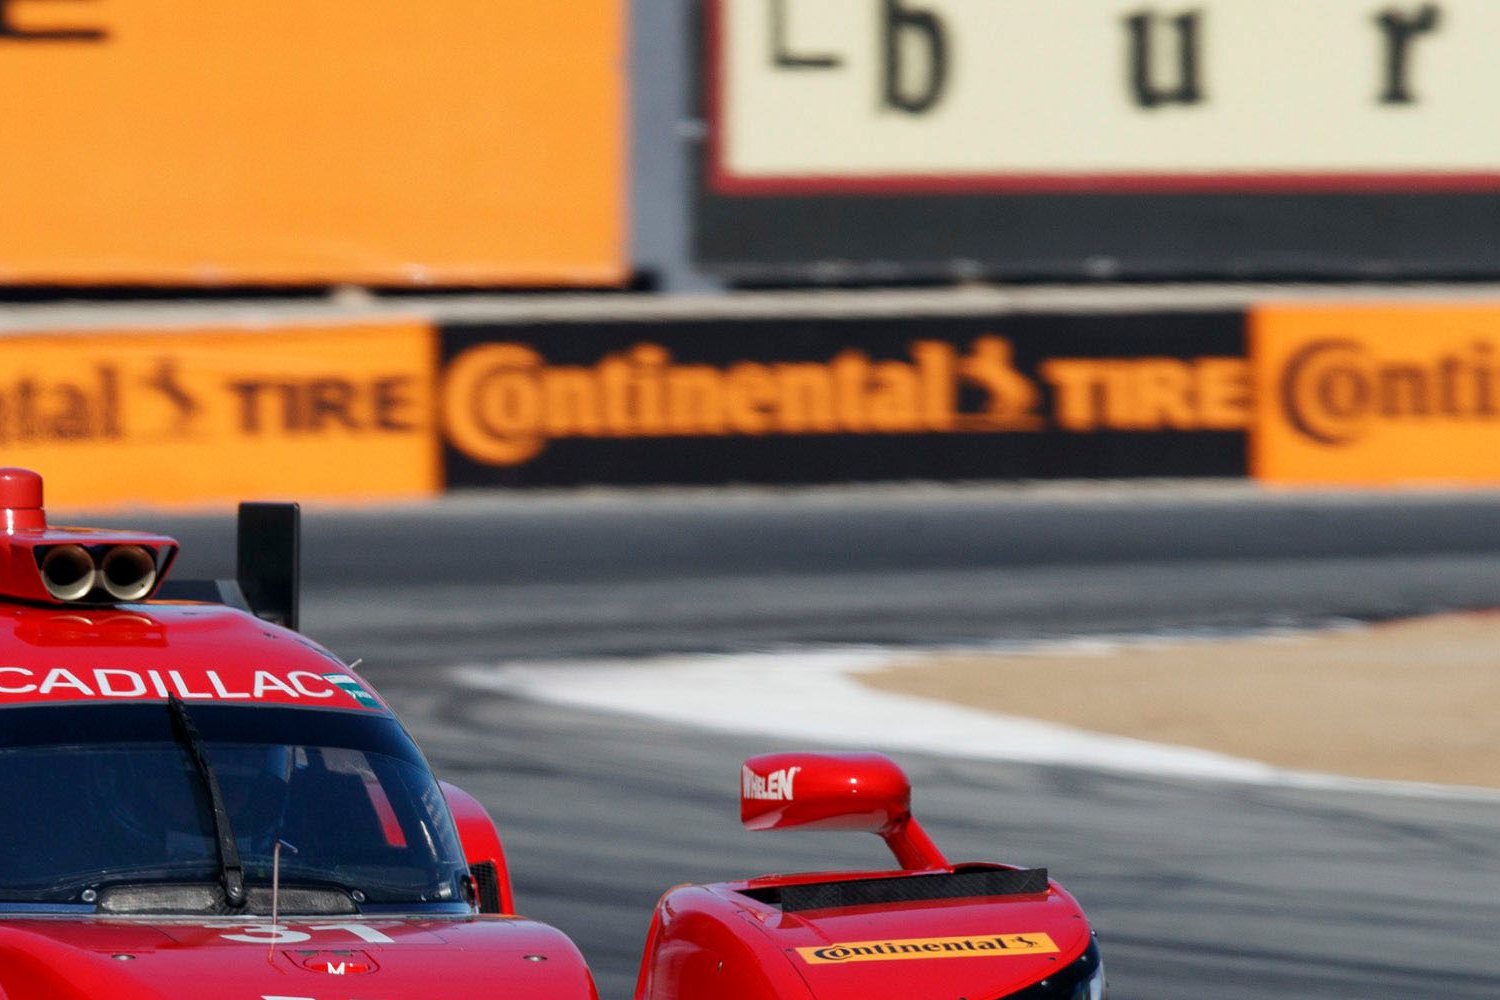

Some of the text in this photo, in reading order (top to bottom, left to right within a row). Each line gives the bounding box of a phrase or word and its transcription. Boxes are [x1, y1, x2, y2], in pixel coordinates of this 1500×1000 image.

[228, 376, 419, 436] TIRE
[444, 338, 1250, 466] Continental TIRE
[742, 764, 794, 800] WHELEN
[204, 923, 395, 944] 31
[814, 938, 1008, 960] Continental
